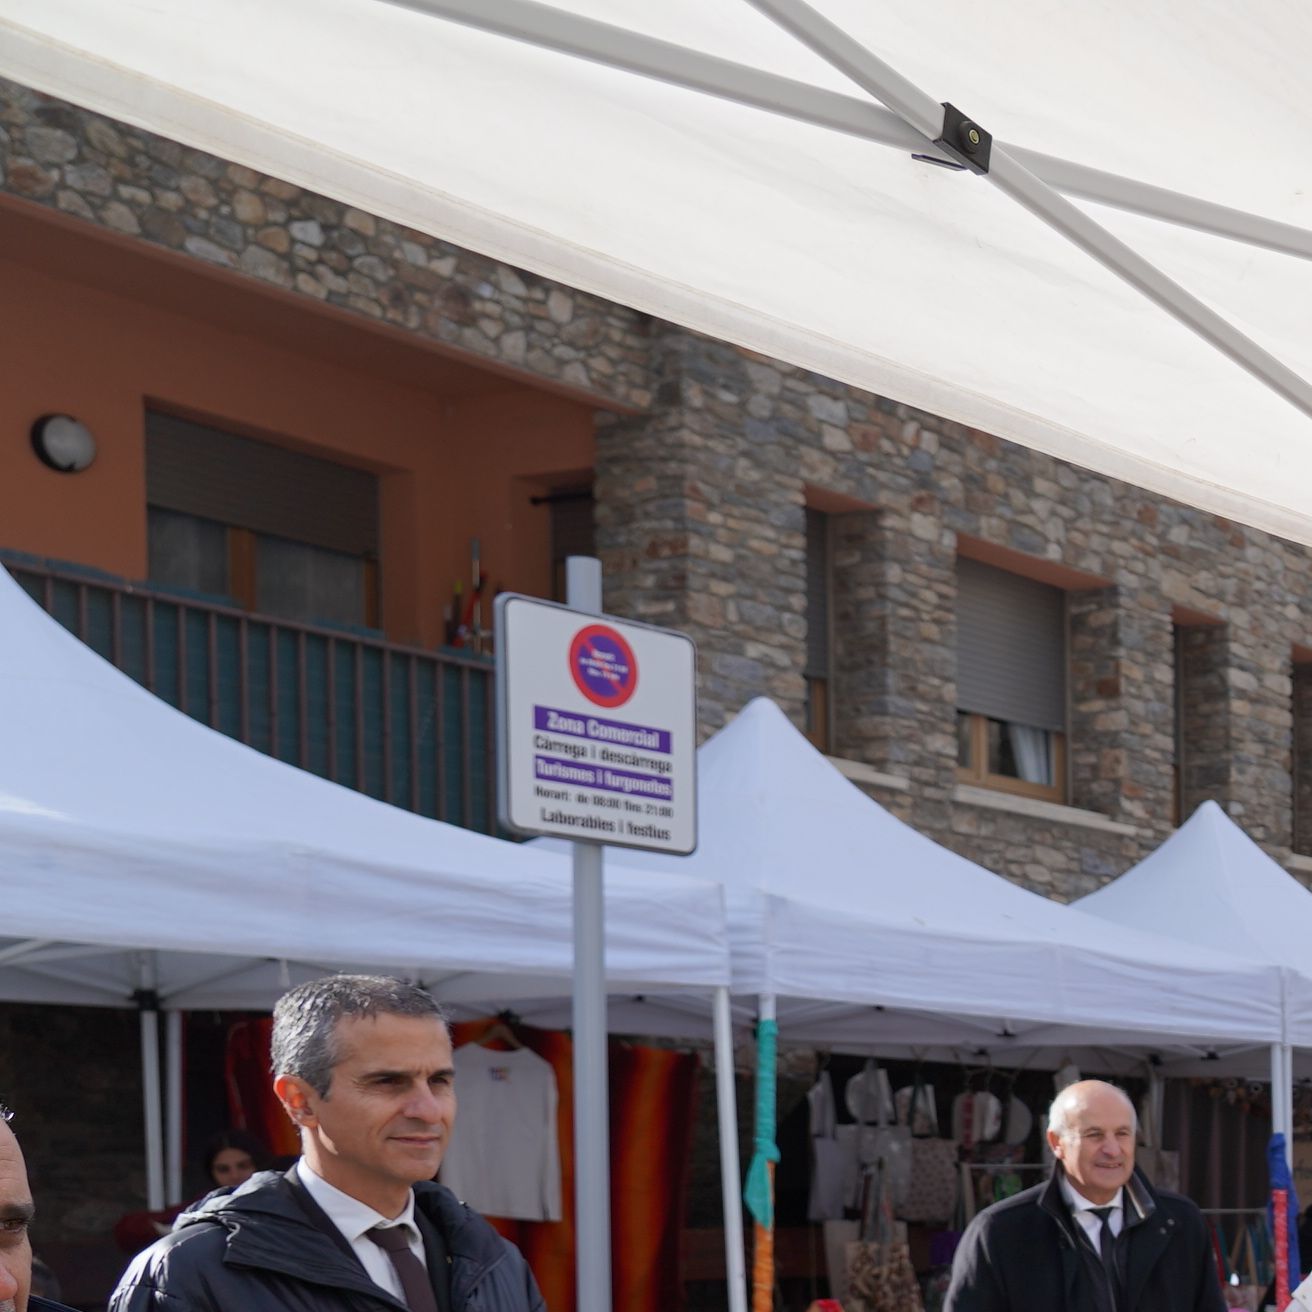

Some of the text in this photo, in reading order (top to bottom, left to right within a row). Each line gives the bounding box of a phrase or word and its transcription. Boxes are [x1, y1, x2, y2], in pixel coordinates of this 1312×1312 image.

[547, 711, 660, 748] Zona Comercial
[533, 734, 588, 760] Càrrega
[600, 747, 673, 774] descàrrega
[537, 758, 595, 784] Turismes
[604, 769, 672, 796] furgonetes
[541, 806, 615, 833] Laborables
[628, 819, 671, 841] festius
